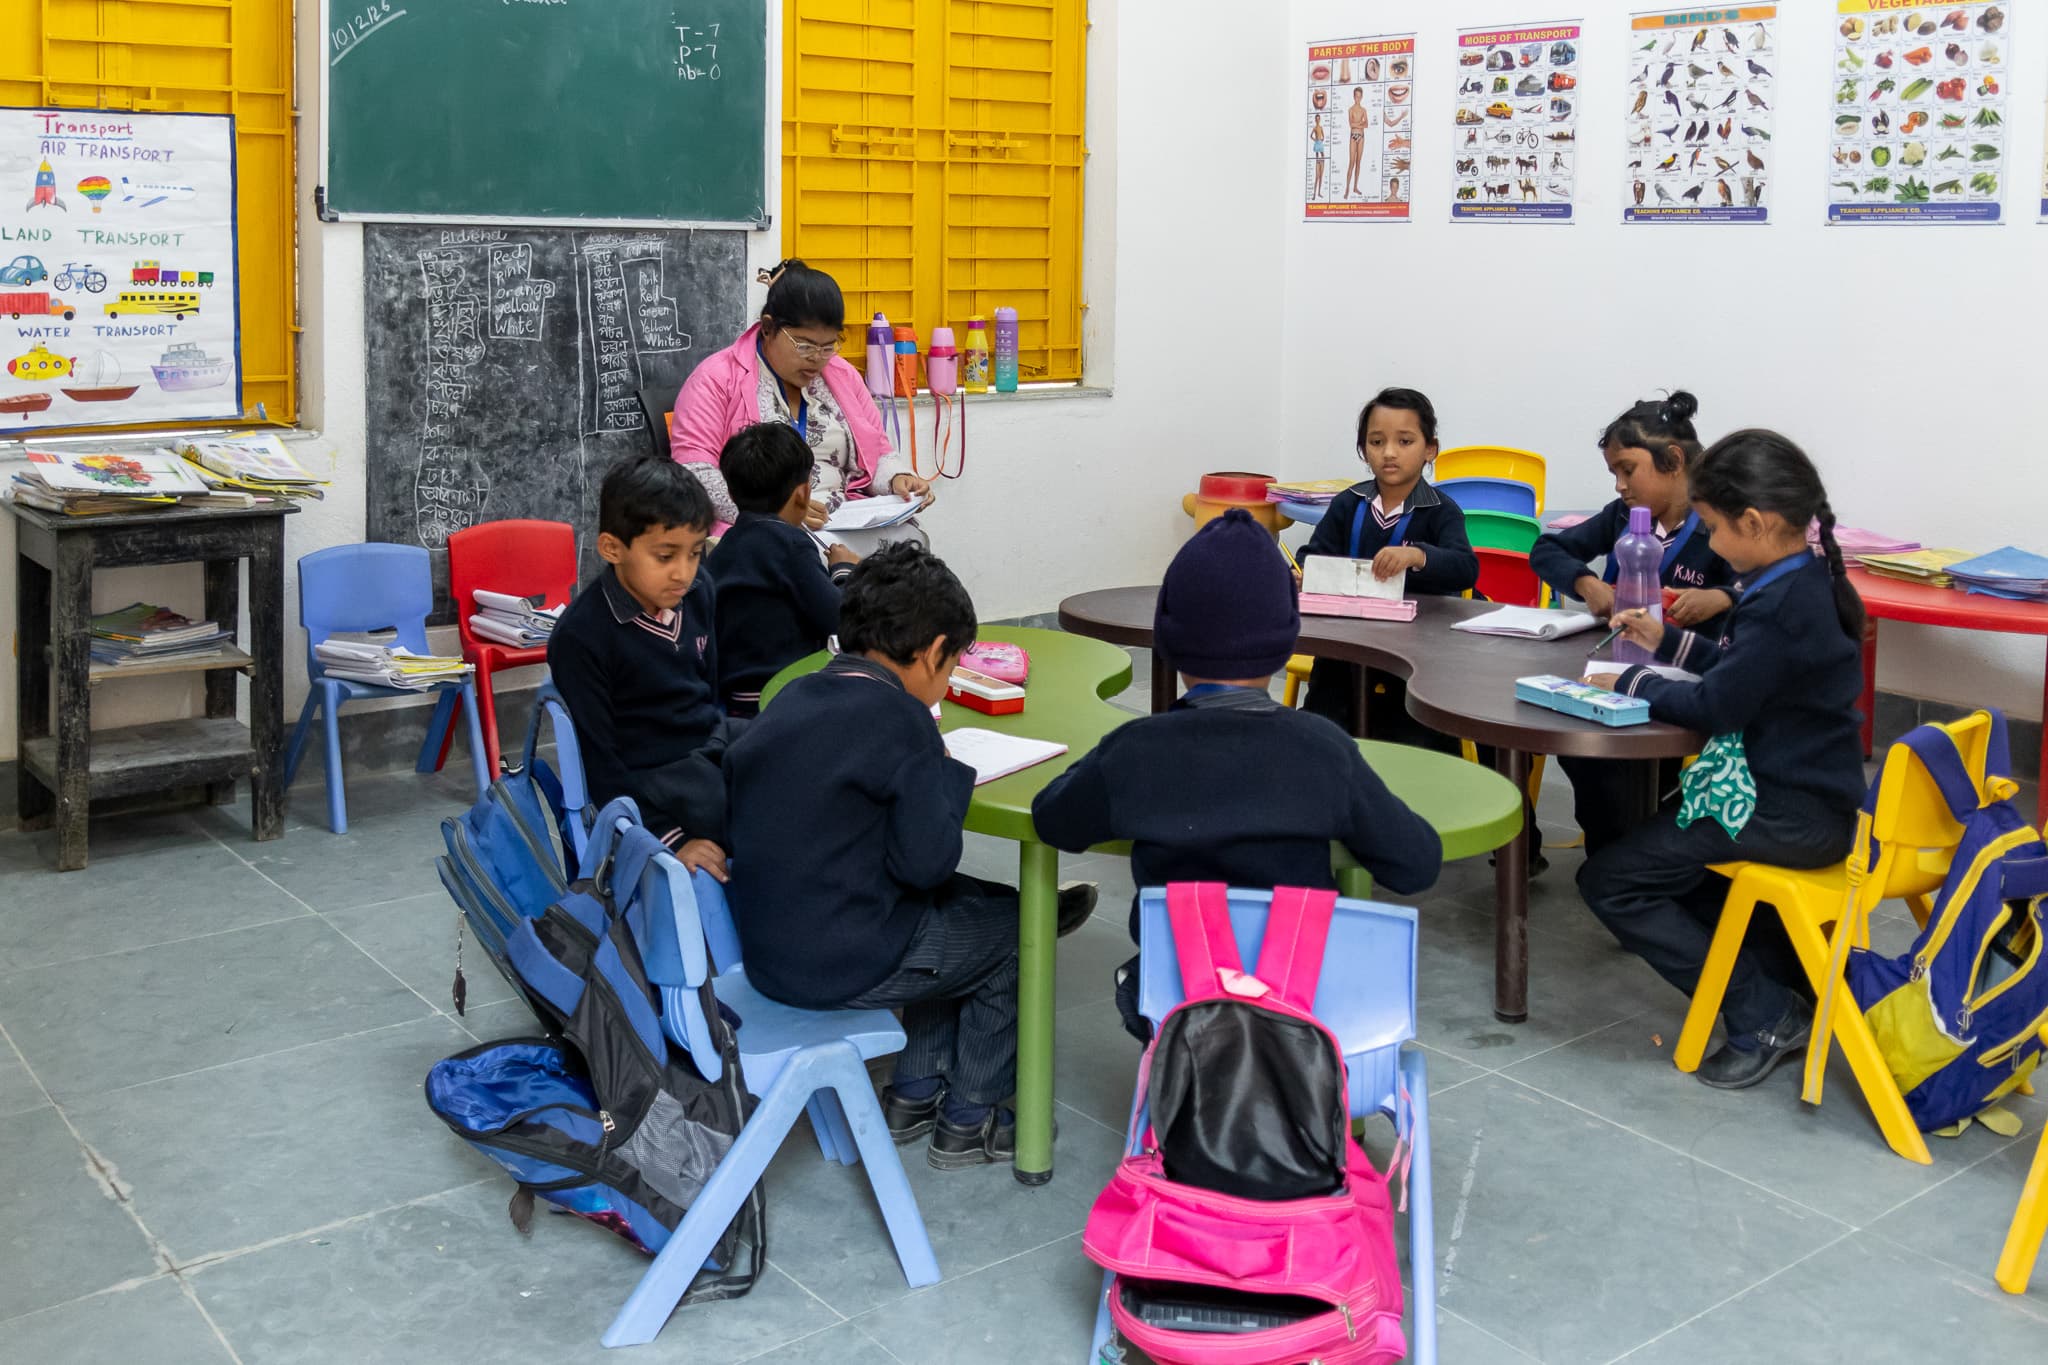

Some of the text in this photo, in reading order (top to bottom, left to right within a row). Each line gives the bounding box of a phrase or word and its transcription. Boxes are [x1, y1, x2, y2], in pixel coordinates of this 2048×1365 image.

[1664, 9, 1740, 25] BIRDS
[1464, 28, 1574, 45] MODES OF TRANSPORT
[1313, 41, 1409, 57] PARTS OF THE BODY
[33, 113, 134, 137] Transport
[40, 140, 175, 163] AIR TRANSPORT
[1, 227, 185, 248] LAND TRANSPORT
[493, 244, 525, 266] Red
[18, 324, 178, 338] WATER TRANSPORT
[640, 319, 673, 334] Yellow
[644, 332, 682, 347] White
